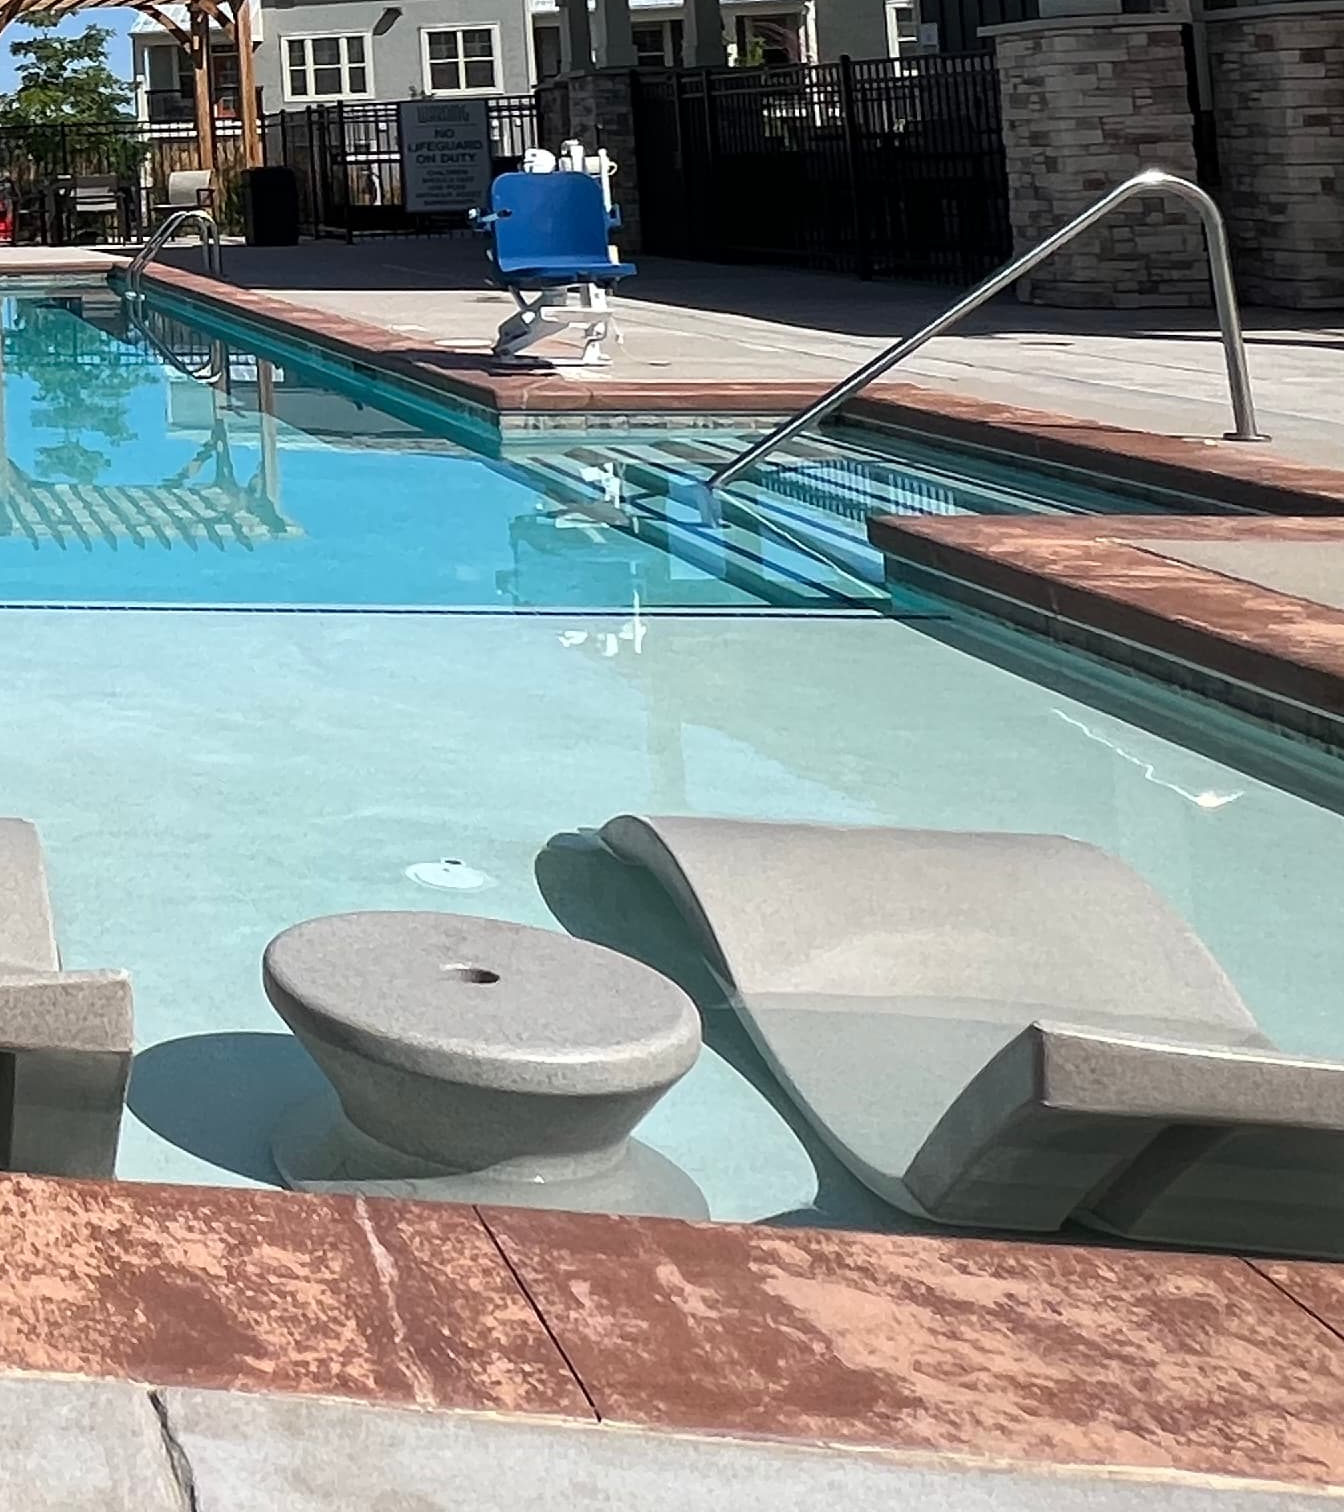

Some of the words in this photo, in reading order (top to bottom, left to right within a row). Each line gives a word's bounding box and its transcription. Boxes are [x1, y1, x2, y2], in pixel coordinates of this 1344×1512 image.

[434, 129, 455, 138] NO
[408, 140, 482, 152] LIFEGUARD
[416, 154, 436, 164] ON
[440, 153, 476, 163] DUTY
